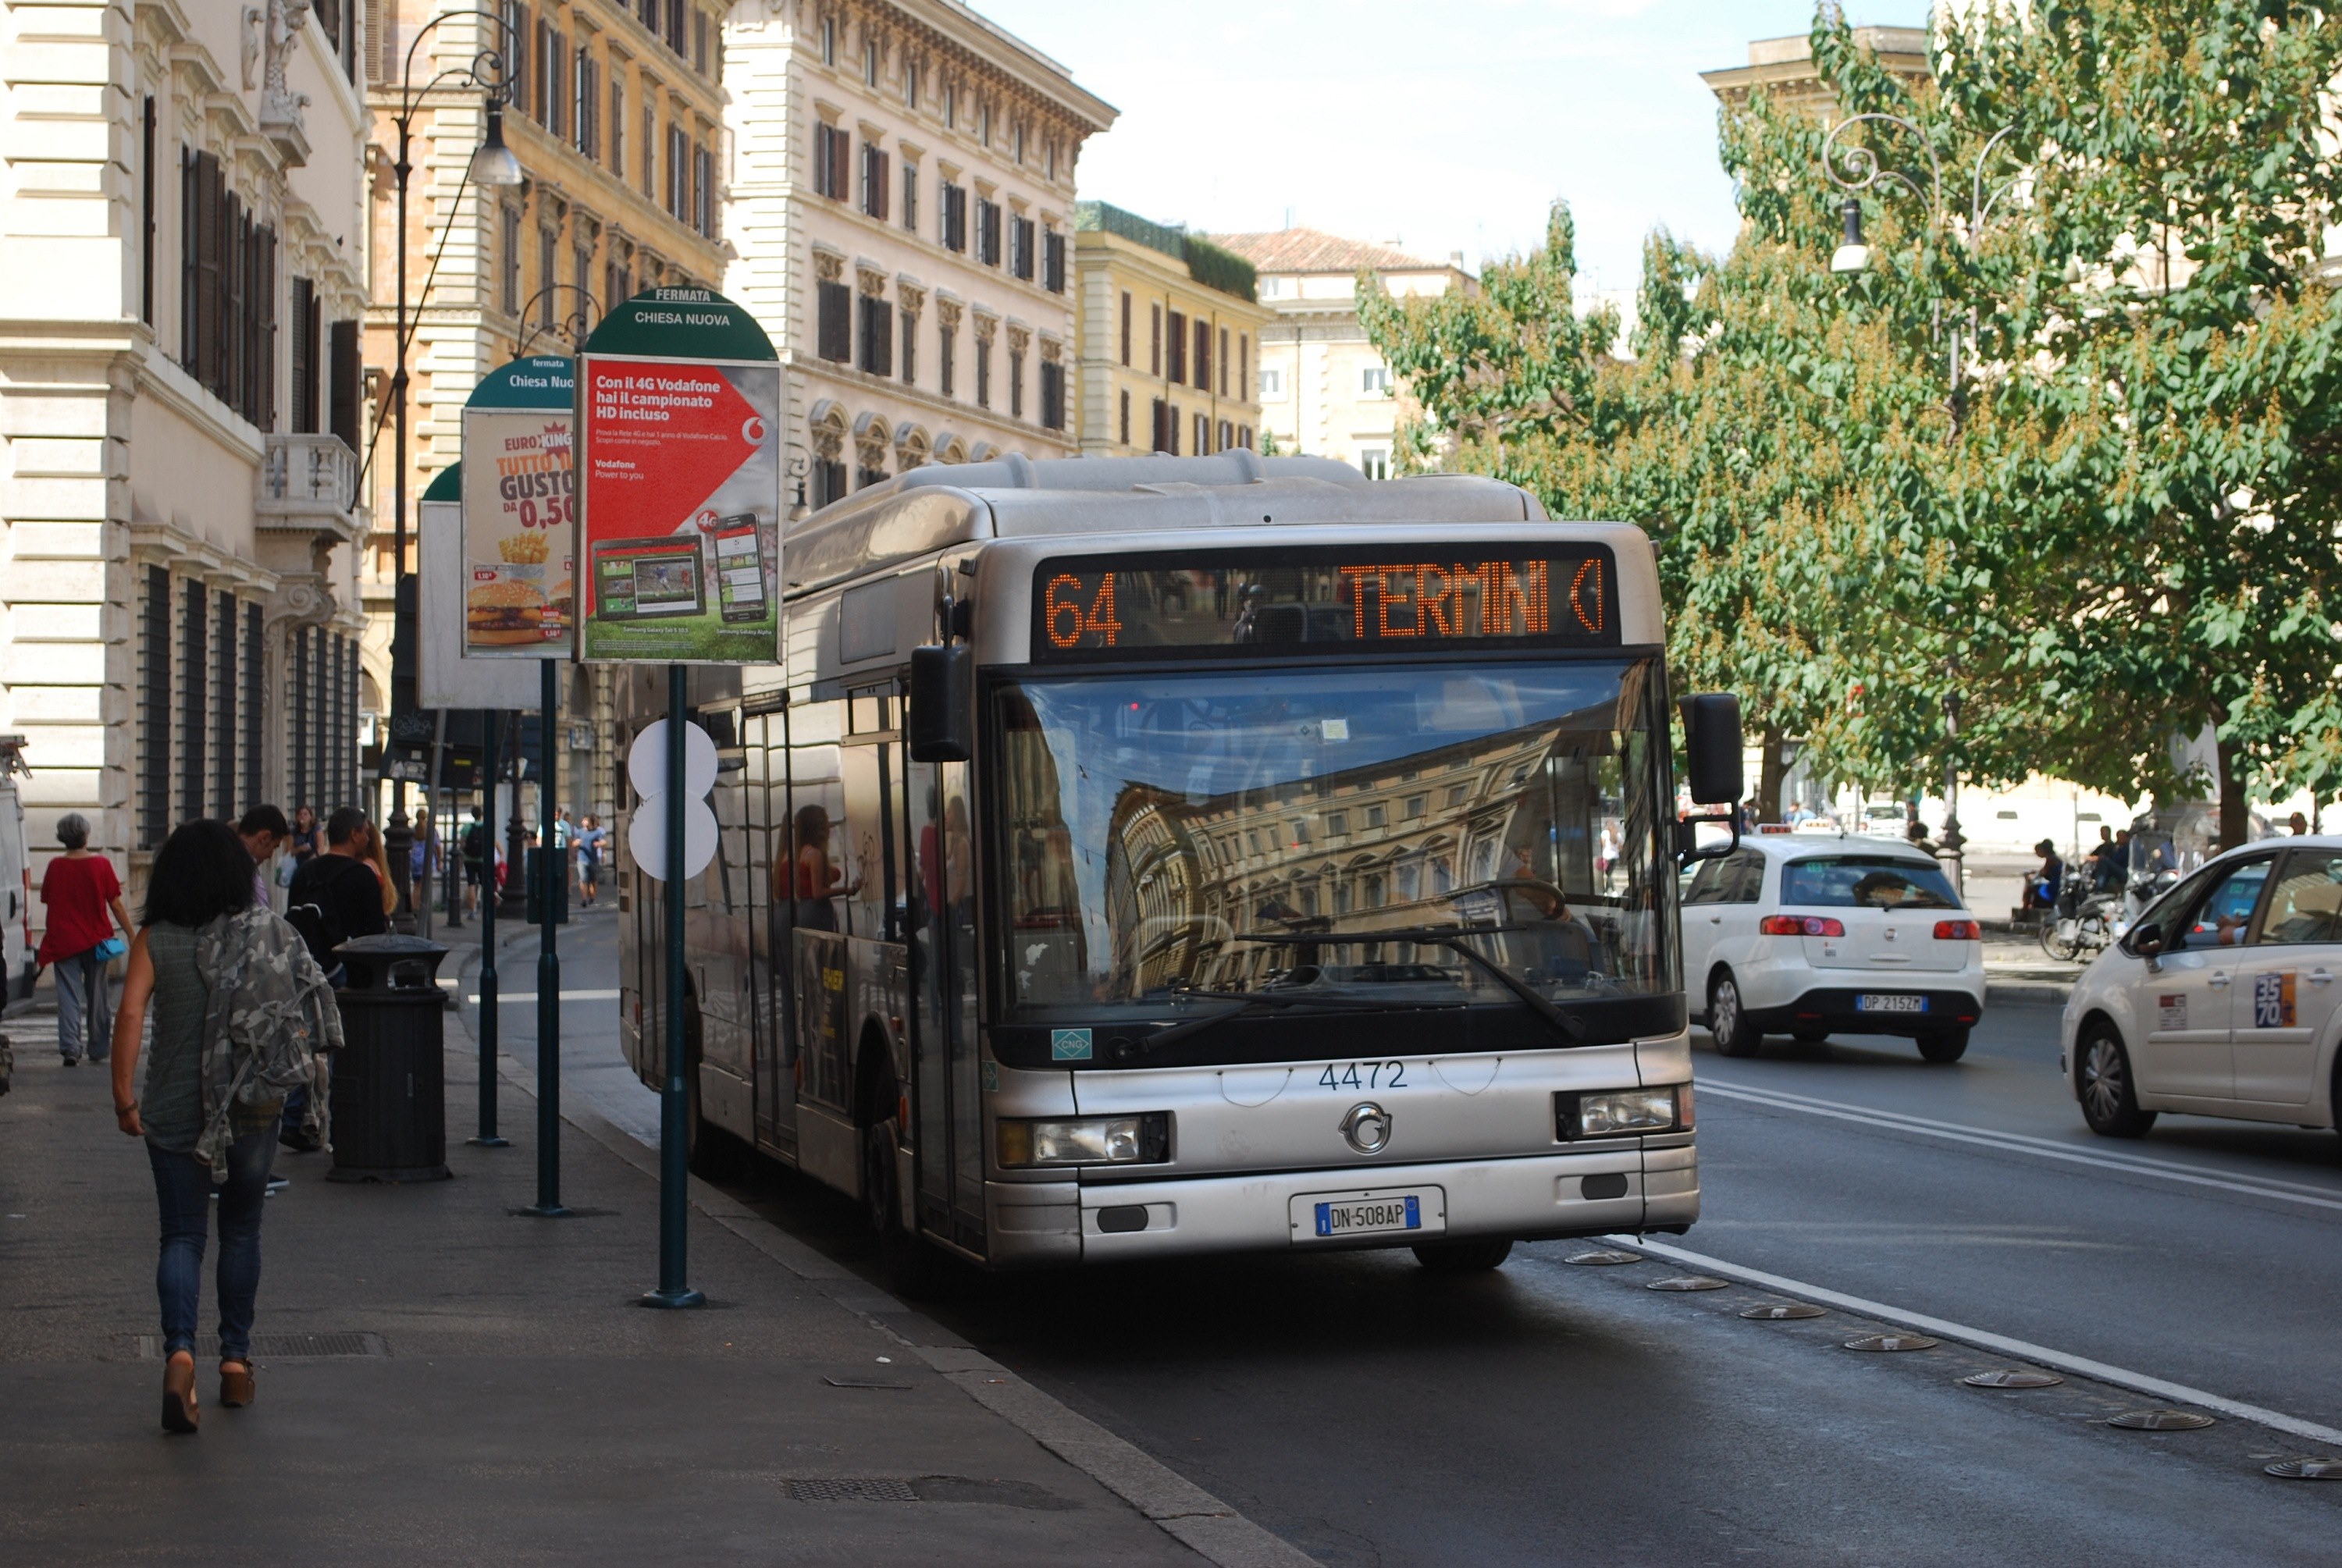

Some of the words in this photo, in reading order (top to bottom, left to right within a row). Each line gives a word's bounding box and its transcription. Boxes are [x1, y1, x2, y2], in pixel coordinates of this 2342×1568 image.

[657, 289, 710, 301] FERMATA
[635, 311, 683, 324] CHIESA
[686, 314, 730, 325] NUOVA
[510, 375, 547, 387] Chiesa
[596, 375, 622, 388] Con
[625, 376, 634, 389] il
[636, 378, 654, 389] 4G
[657, 378, 721, 393] Vodafone
[596, 390, 617, 404] hai
[621, 392, 629, 404] il
[632, 393, 712, 408] campionato
[596, 406, 617, 418] HD
[619, 407, 670, 421] incluso
[504, 436, 537, 451] EURO
[541, 432, 573, 447] KING
[496, 453, 553, 478] TUTTO
[596, 460, 635, 468] Vodafone
[596, 470, 618, 478] Power
[629, 472, 644, 481] you
[503, 502, 518, 513] DA
[698, 512, 717, 527] 4G
[1045, 572, 1123, 648] 64
[1340, 560, 1549, 638] TERMINI
[2258, 978, 2280, 1001] 35
[1864, 996, 1879, 1008] DP
[1062, 1040, 1083, 1049] CNG
[1319, 1060, 1408, 1090] 4472
